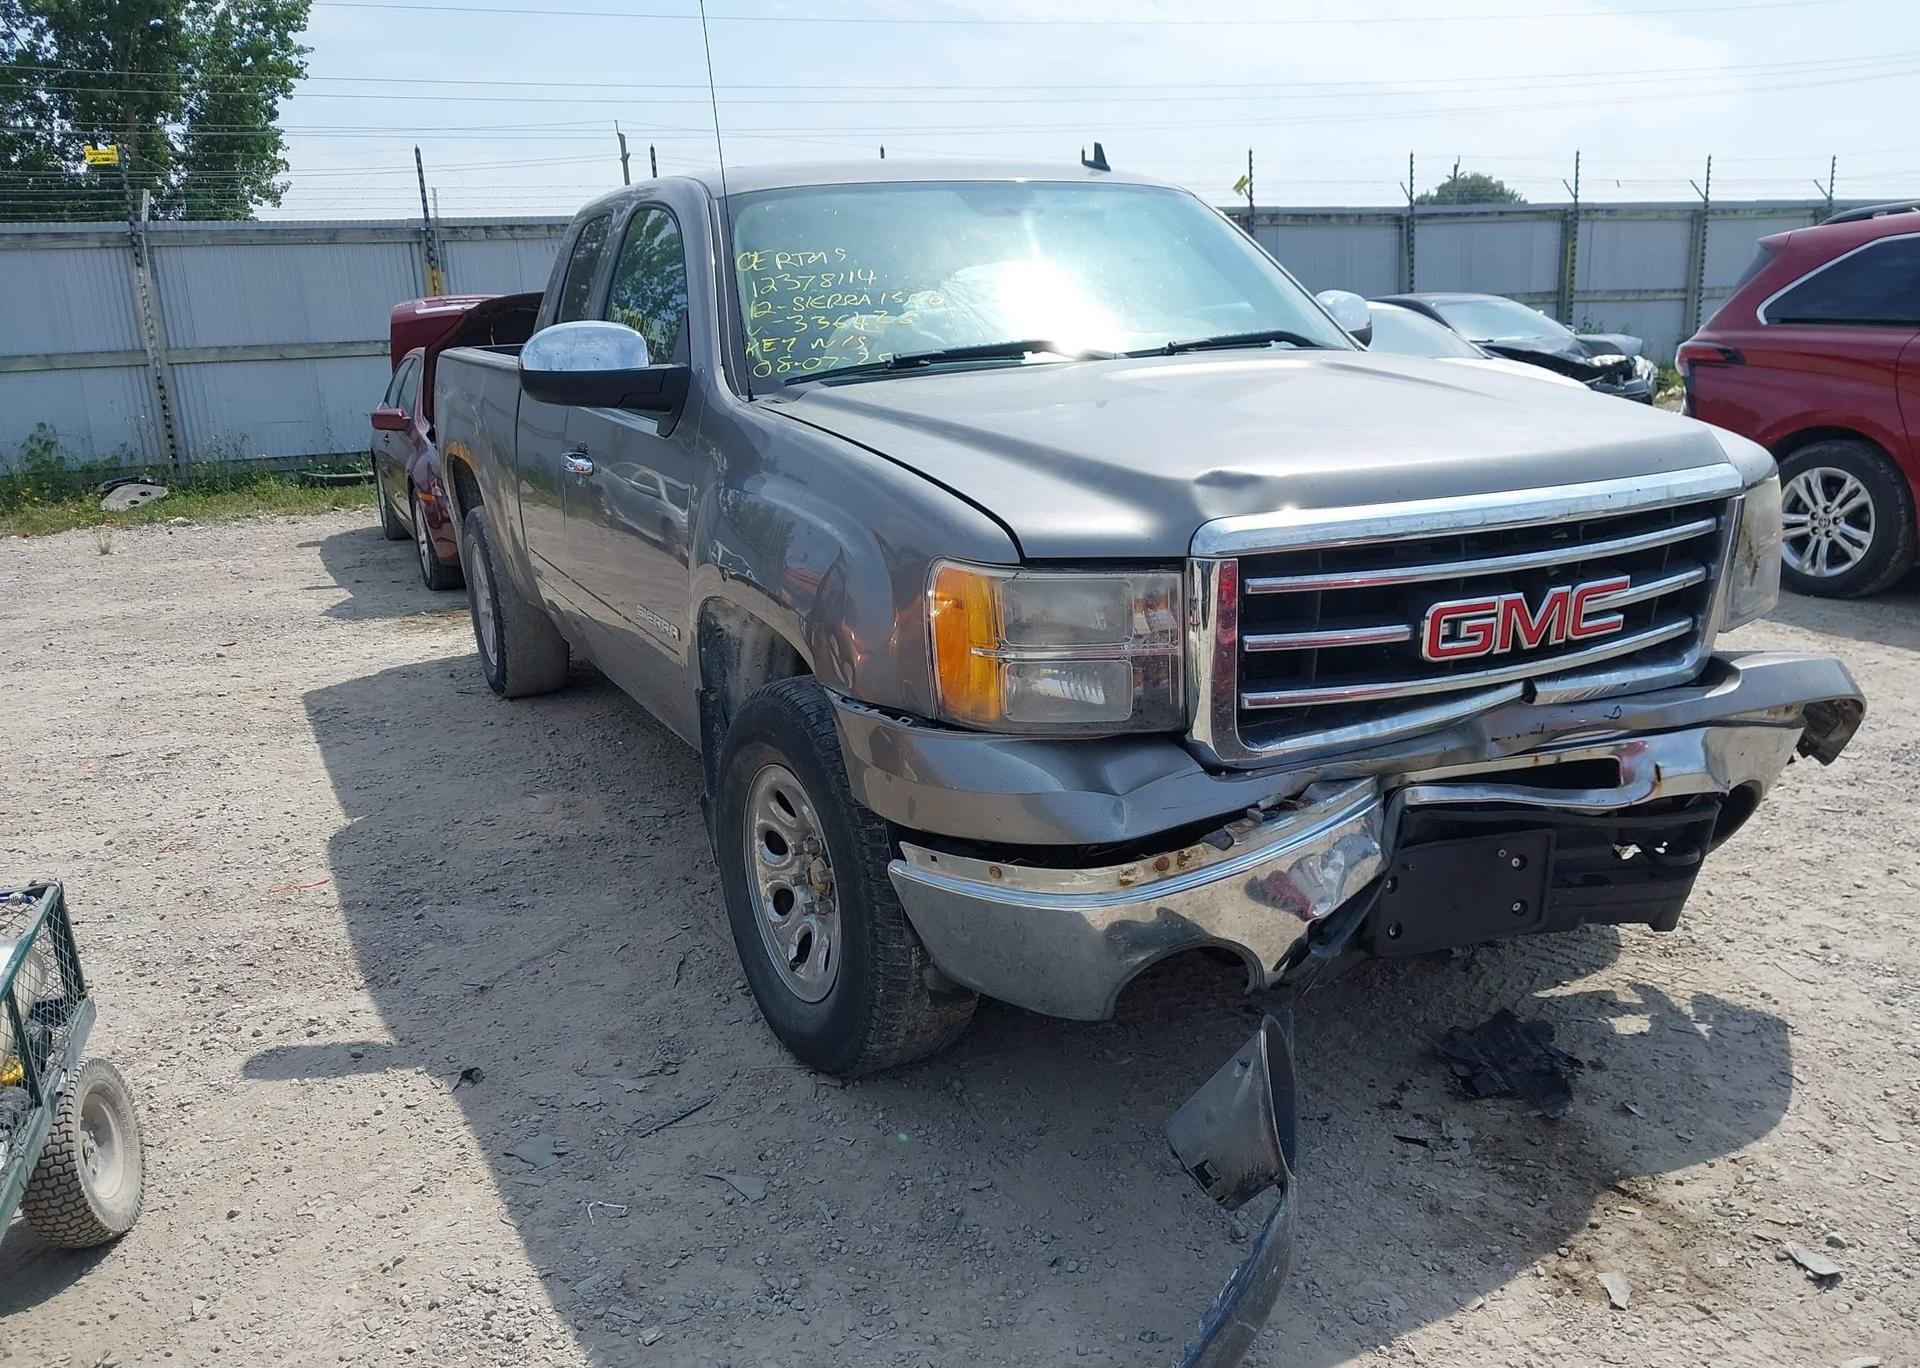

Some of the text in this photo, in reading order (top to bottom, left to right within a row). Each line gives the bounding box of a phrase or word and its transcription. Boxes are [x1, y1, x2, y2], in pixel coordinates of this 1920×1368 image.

[752, 268, 877, 297] 12378114
[746, 337, 798, 357] KEY
[1422, 575, 1631, 661] GMC
